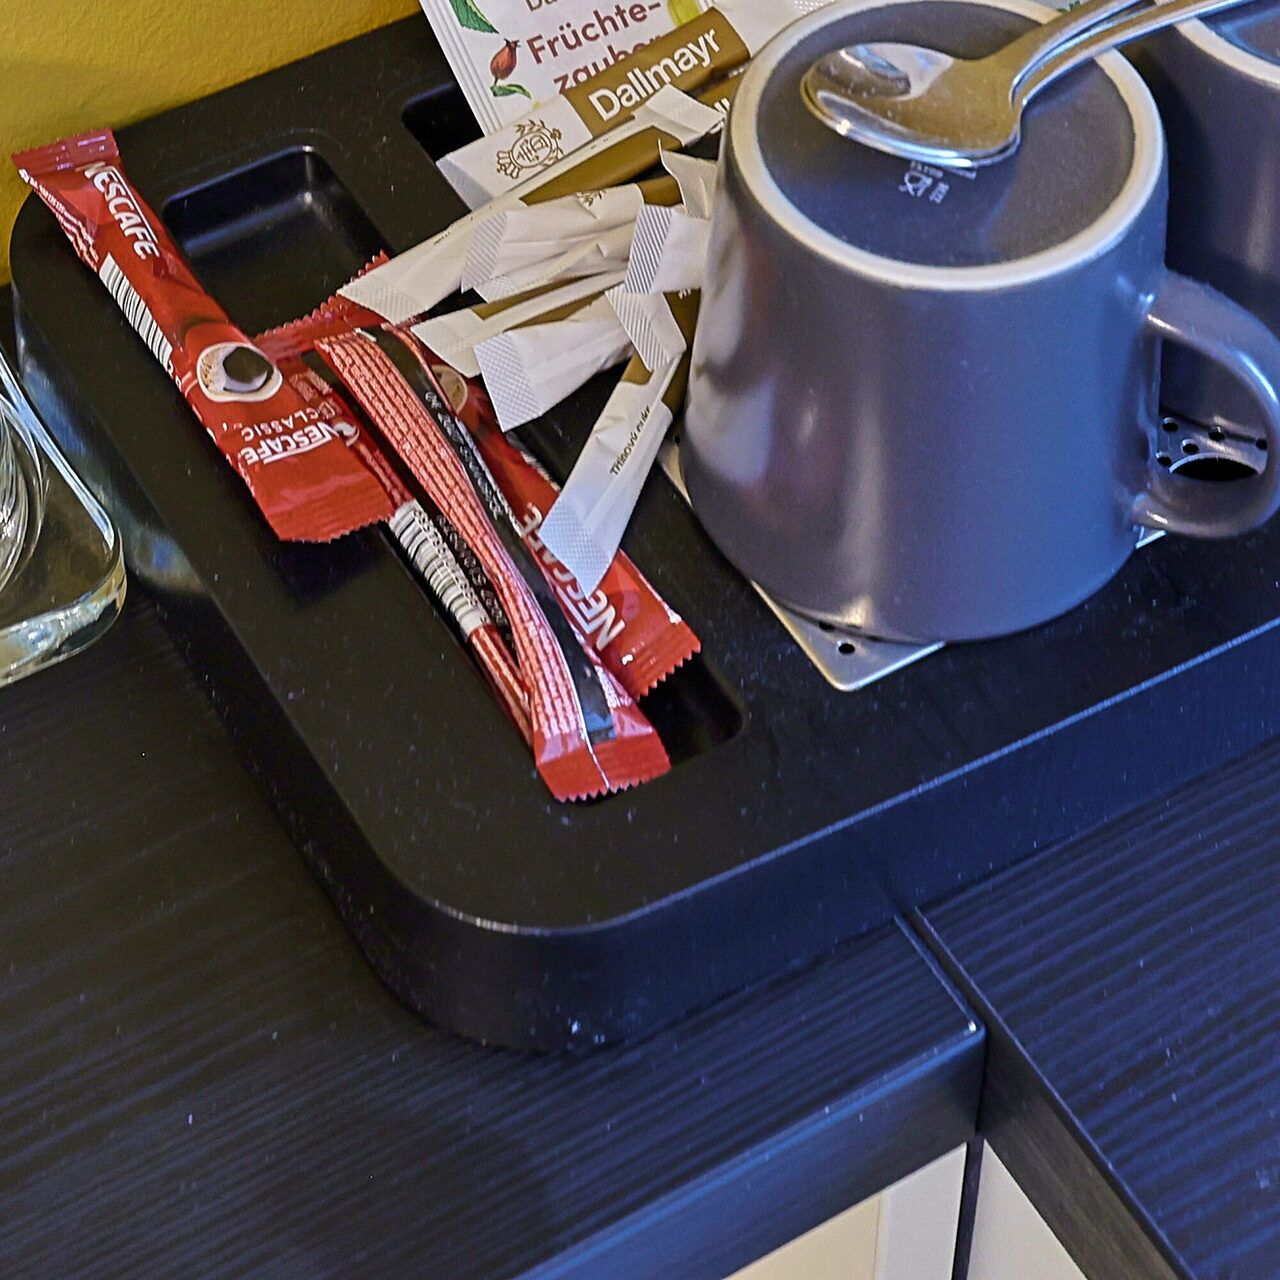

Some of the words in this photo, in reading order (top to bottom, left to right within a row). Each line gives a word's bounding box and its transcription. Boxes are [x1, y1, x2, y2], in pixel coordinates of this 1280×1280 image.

[526, 2, 661, 65] Früchte-
[588, 28, 720, 122] Dallmayr
[241, 407, 319, 442] CLASSIC
